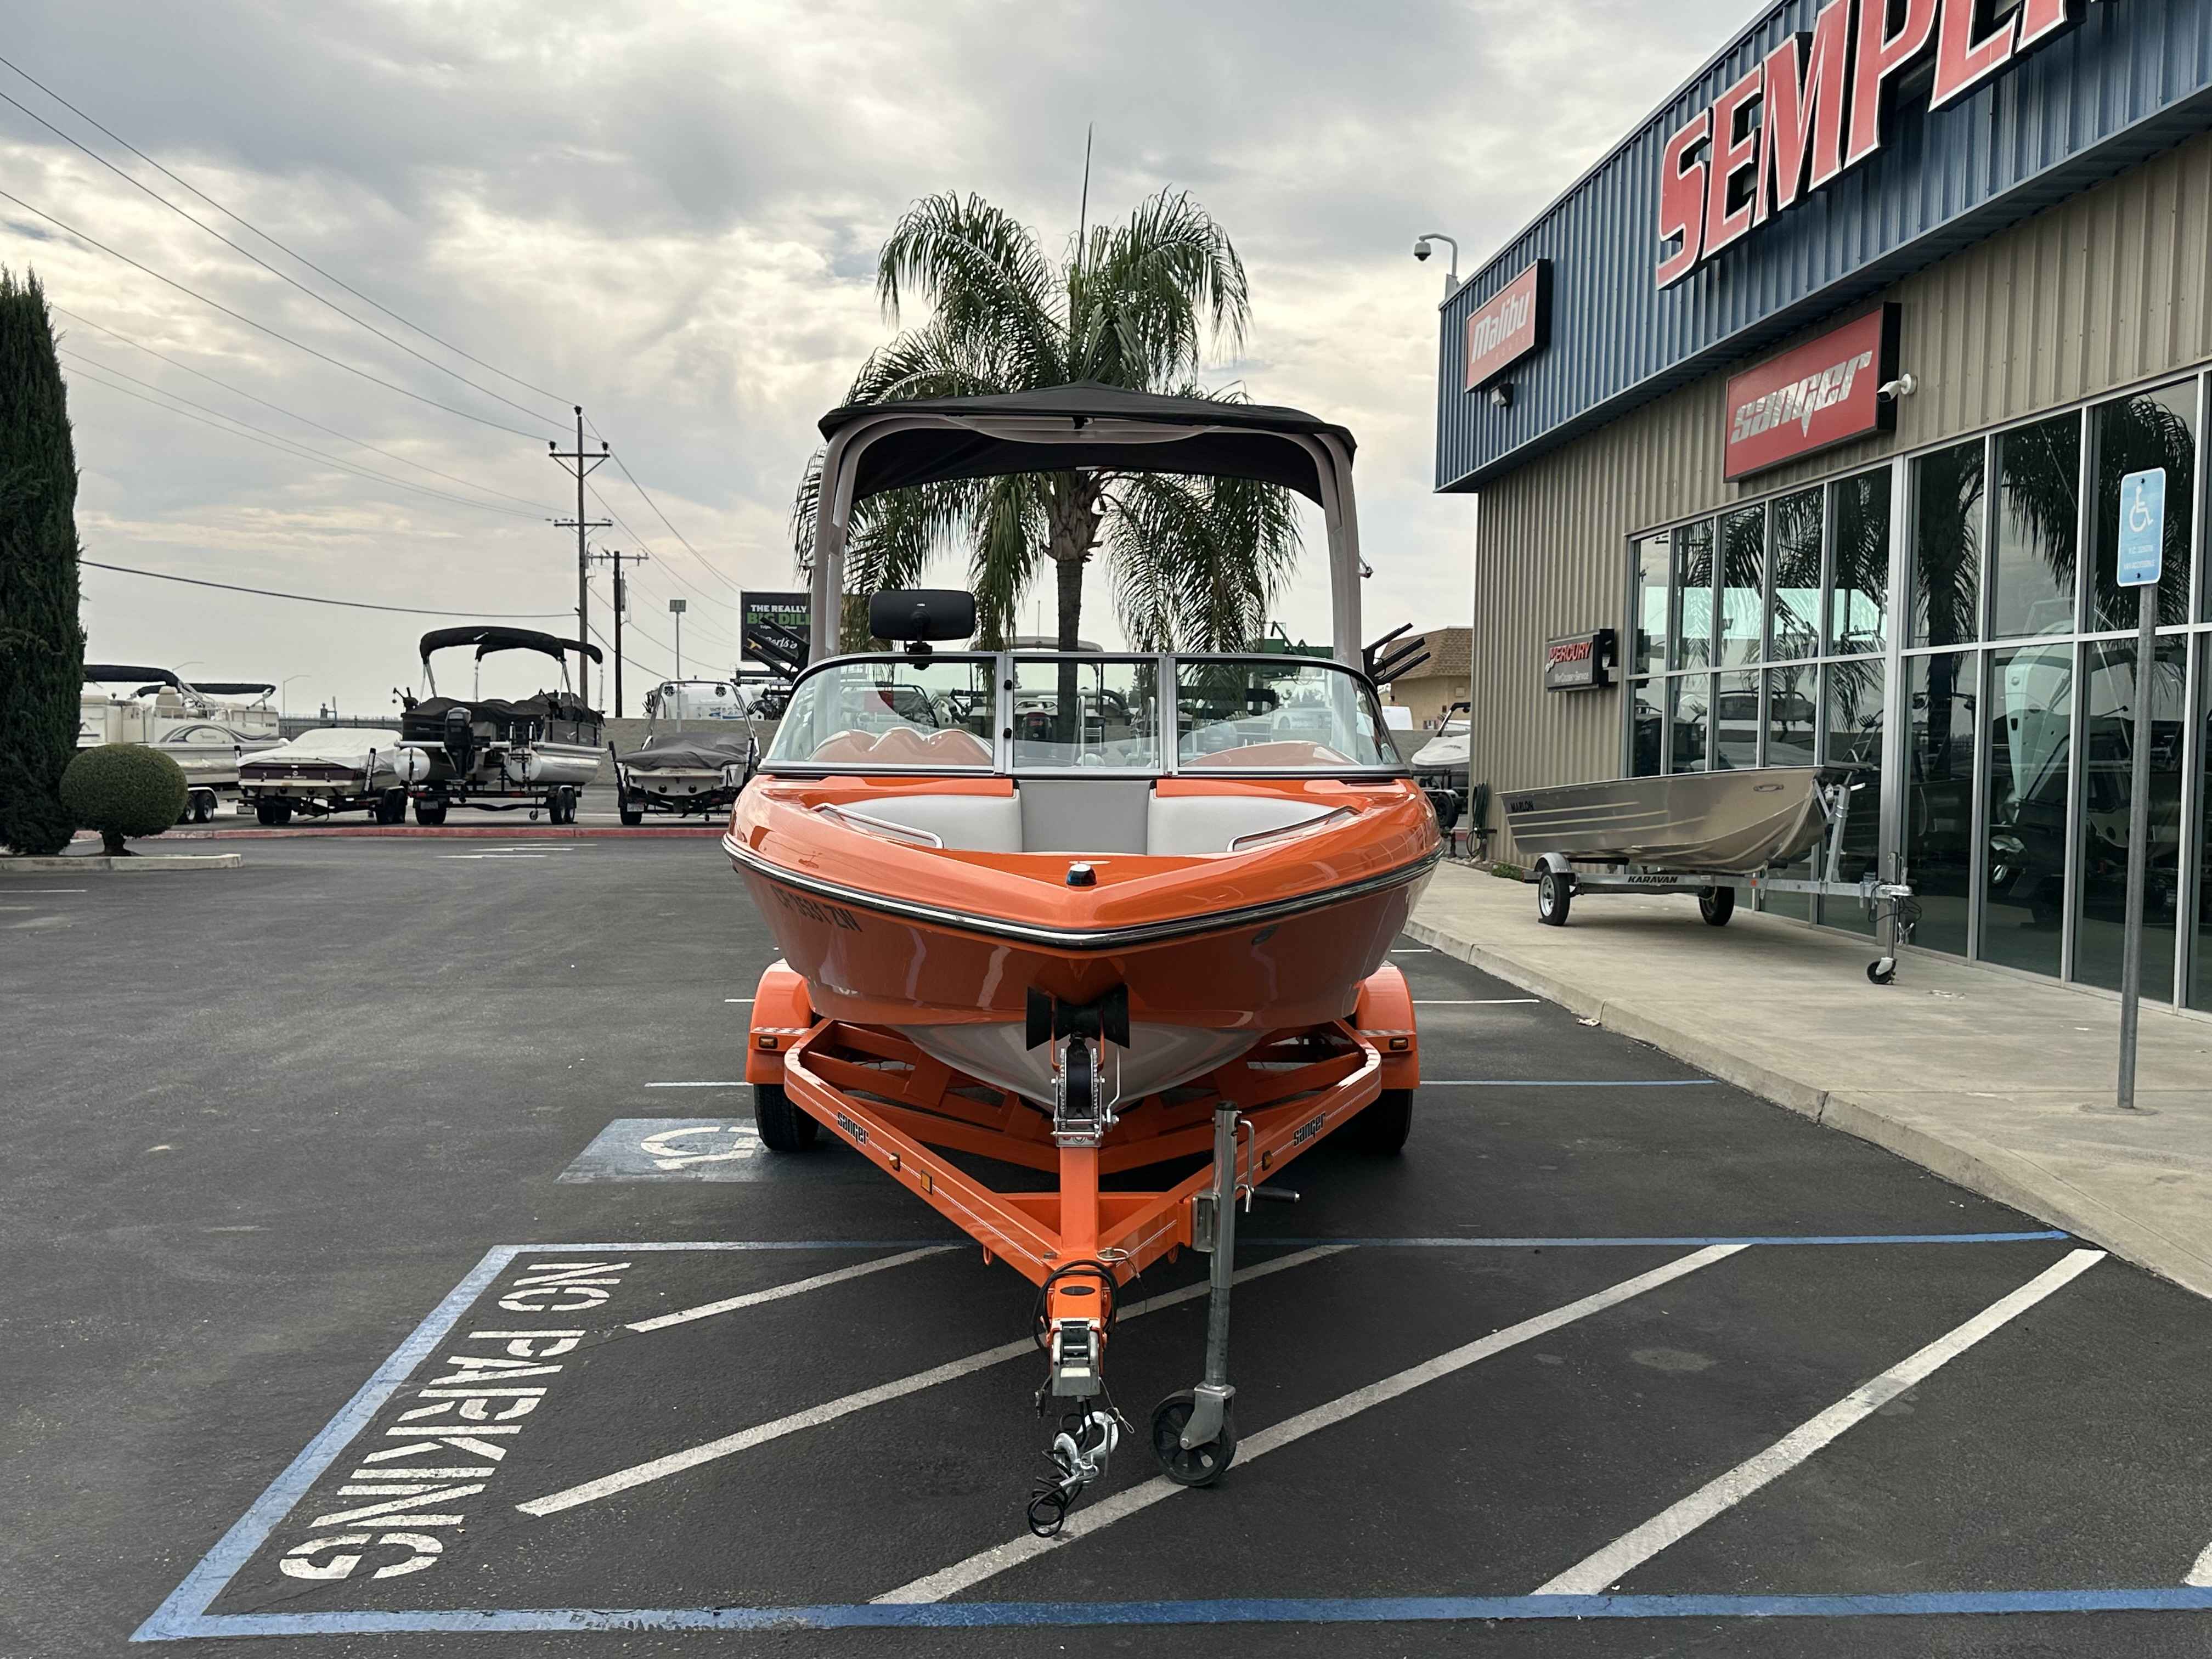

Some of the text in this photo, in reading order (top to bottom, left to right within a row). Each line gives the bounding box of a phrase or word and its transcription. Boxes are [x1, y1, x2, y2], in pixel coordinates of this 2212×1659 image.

[1471, 290, 1530, 364] Malibu
[1549, 641, 1593, 663] MERCURY
[498, 1262, 631, 1312] NO
[279, 1330, 586, 1580] PARKING
